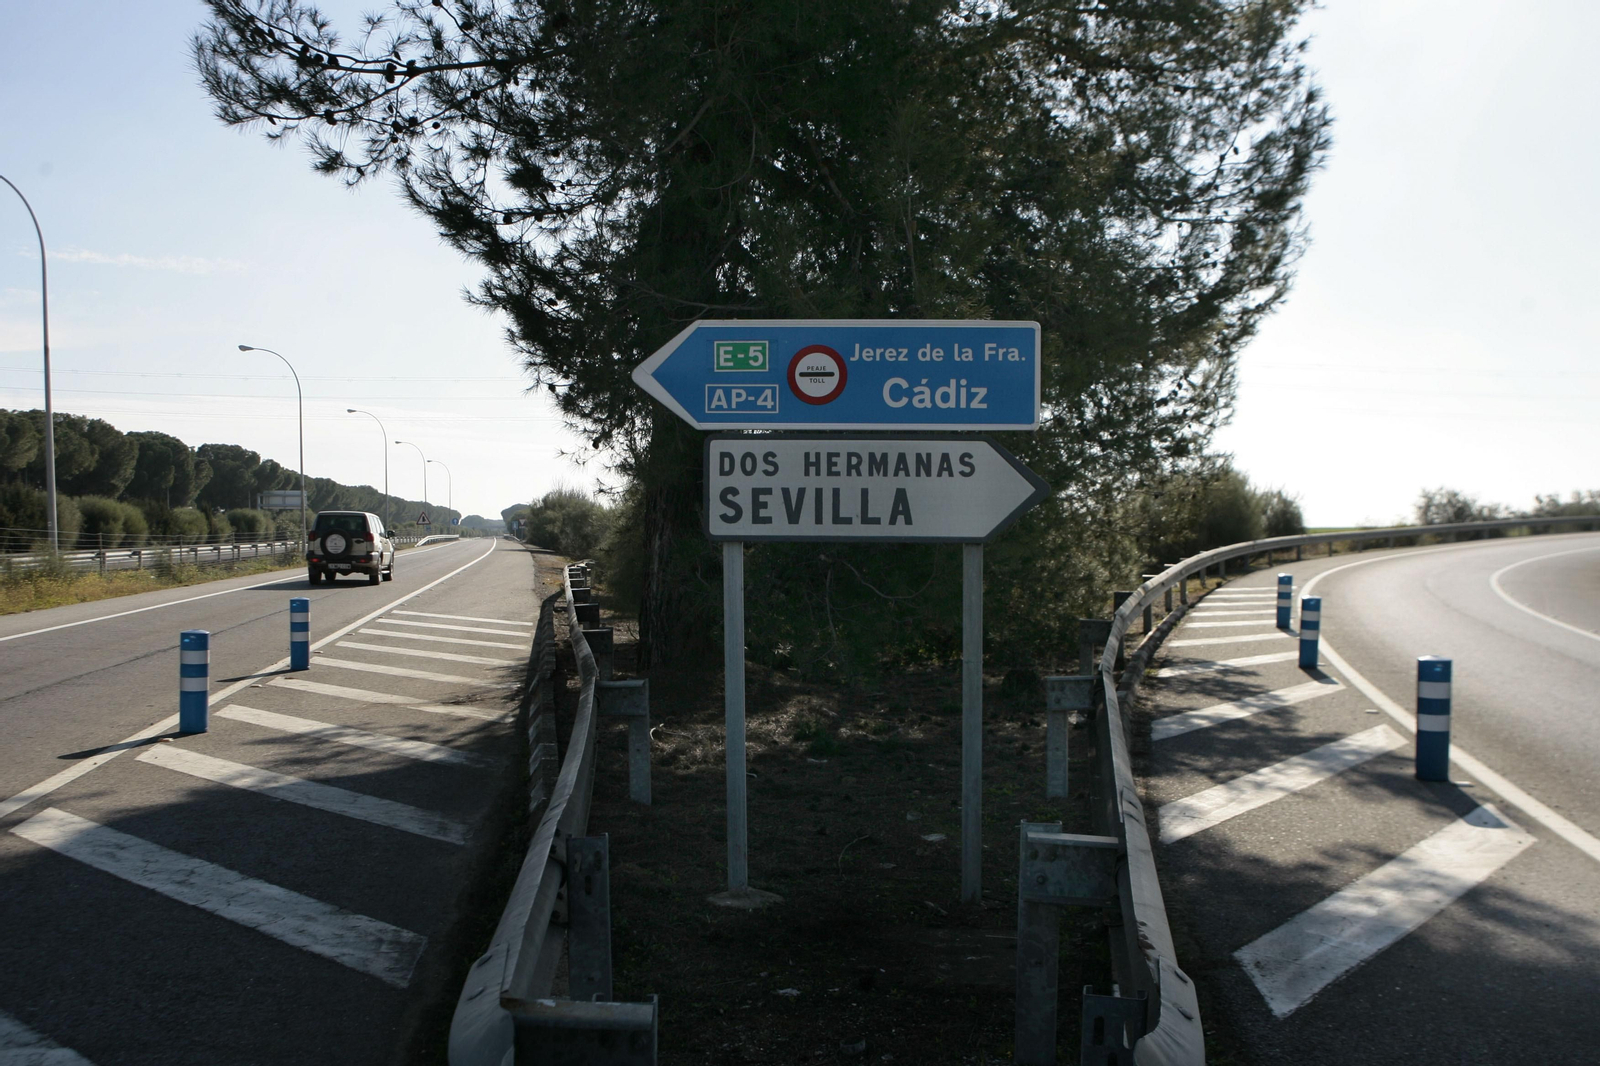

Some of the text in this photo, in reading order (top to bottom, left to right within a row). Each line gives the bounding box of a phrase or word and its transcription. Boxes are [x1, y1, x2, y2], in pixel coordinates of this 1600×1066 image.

[719, 346, 764, 366] E-5
[850, 343, 1026, 361] Jerez de la Fra.
[710, 388, 774, 409] AP-4
[882, 377, 988, 409] Cádiz
[719, 451, 976, 478] DOS HERMANAS
[719, 486, 913, 525] SEVILLA
